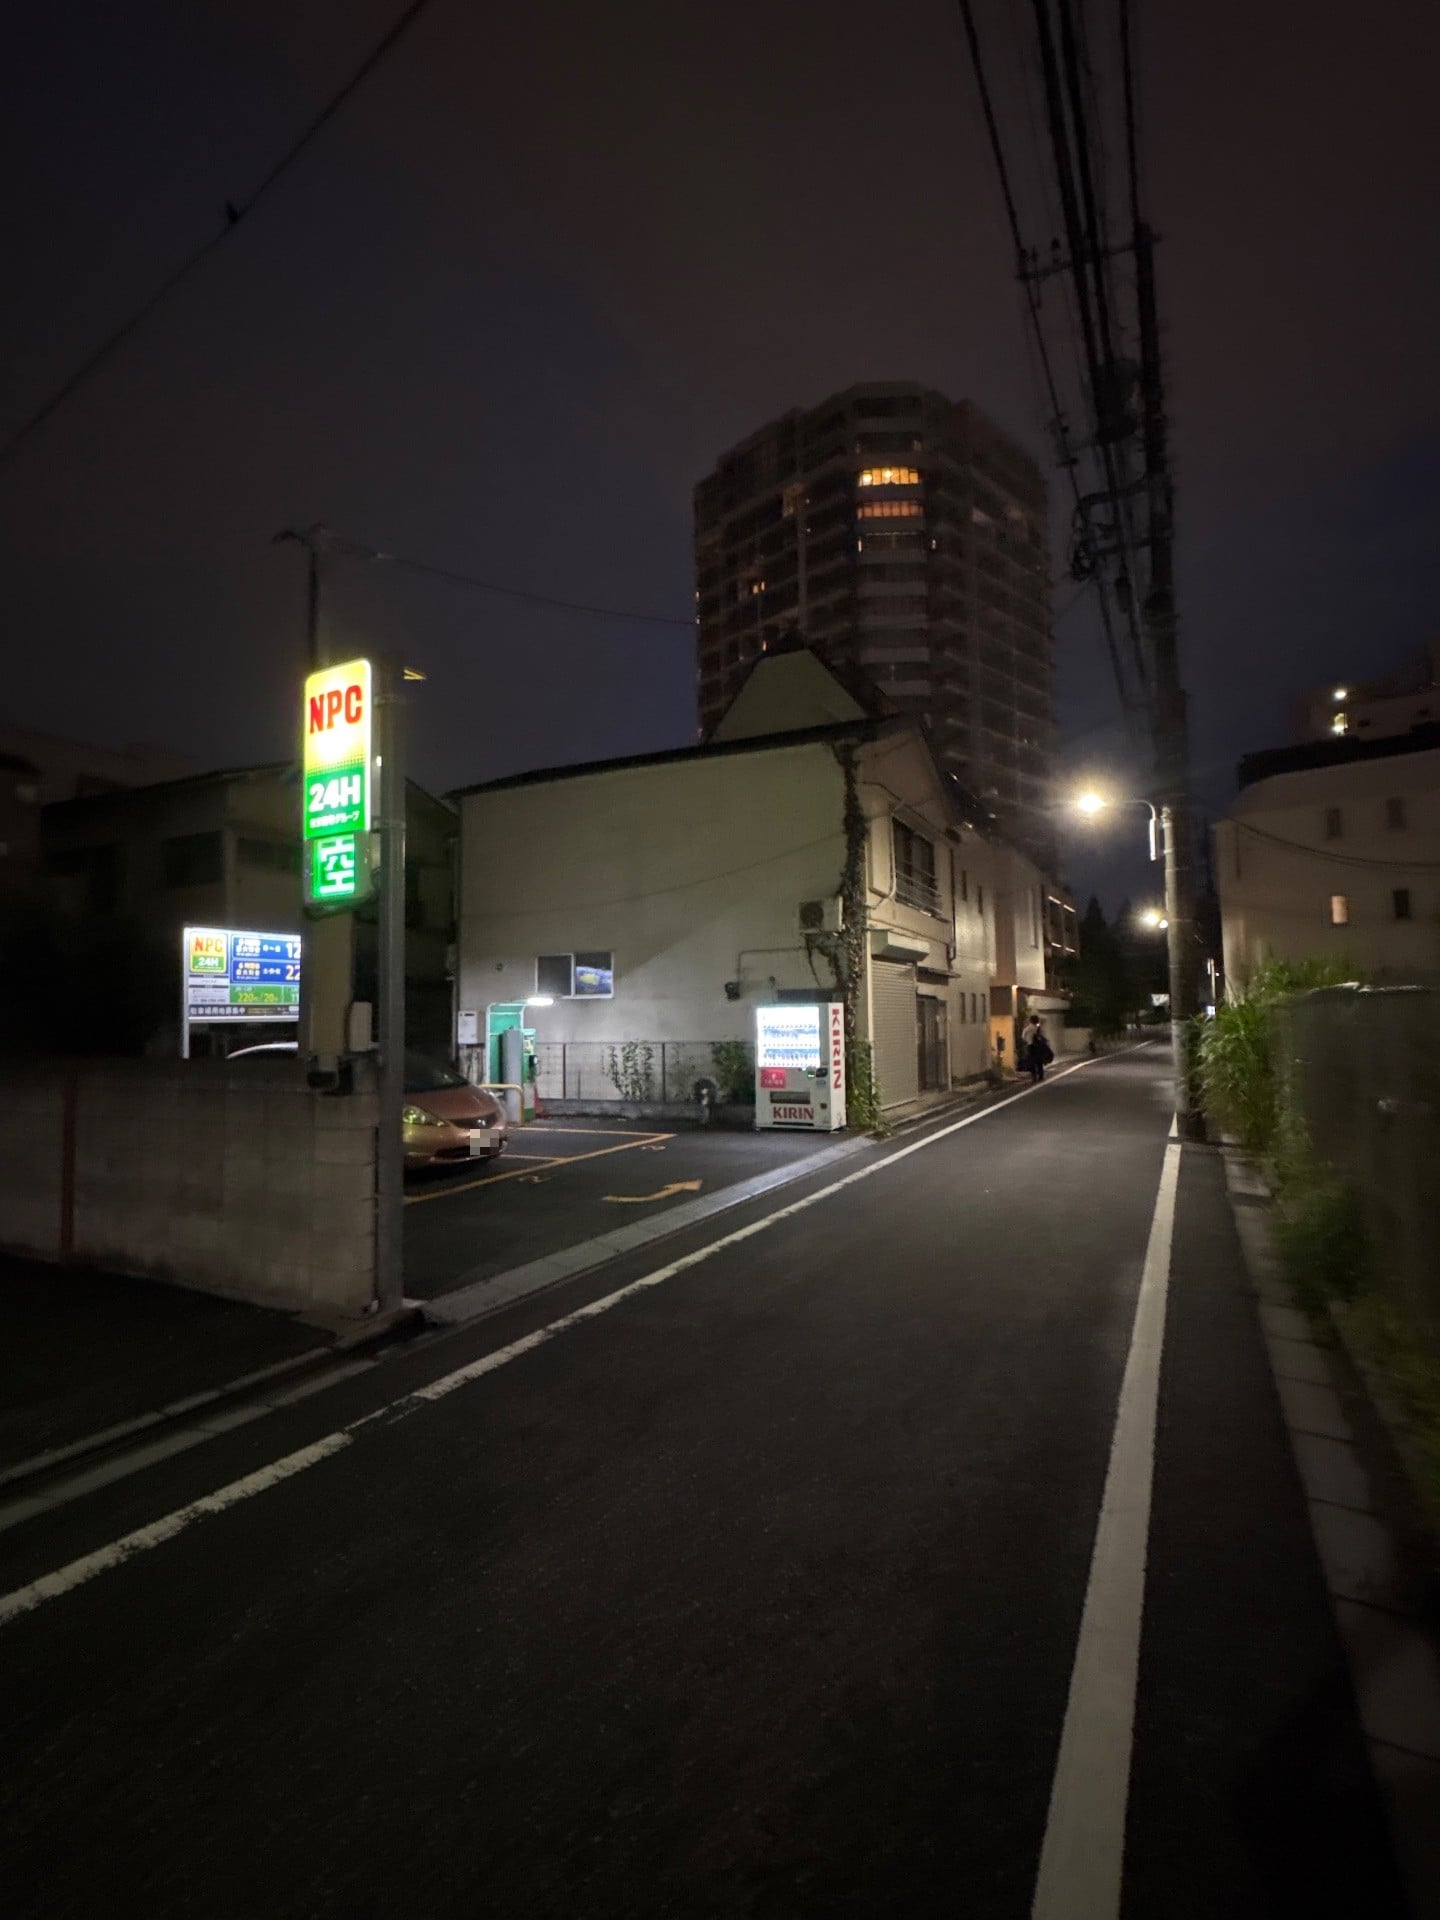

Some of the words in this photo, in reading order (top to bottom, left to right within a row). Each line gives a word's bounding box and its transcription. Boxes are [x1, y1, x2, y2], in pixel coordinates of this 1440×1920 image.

[309, 684, 363, 735] NPC
[308, 774, 361, 813] 24H
[319, 834, 355, 897] 空
[195, 937, 223, 952] NPC
[198, 958, 218, 966] 24H
[832, 1009, 841, 1088] KIRIN
[773, 1108, 813, 1119] KIRIN
